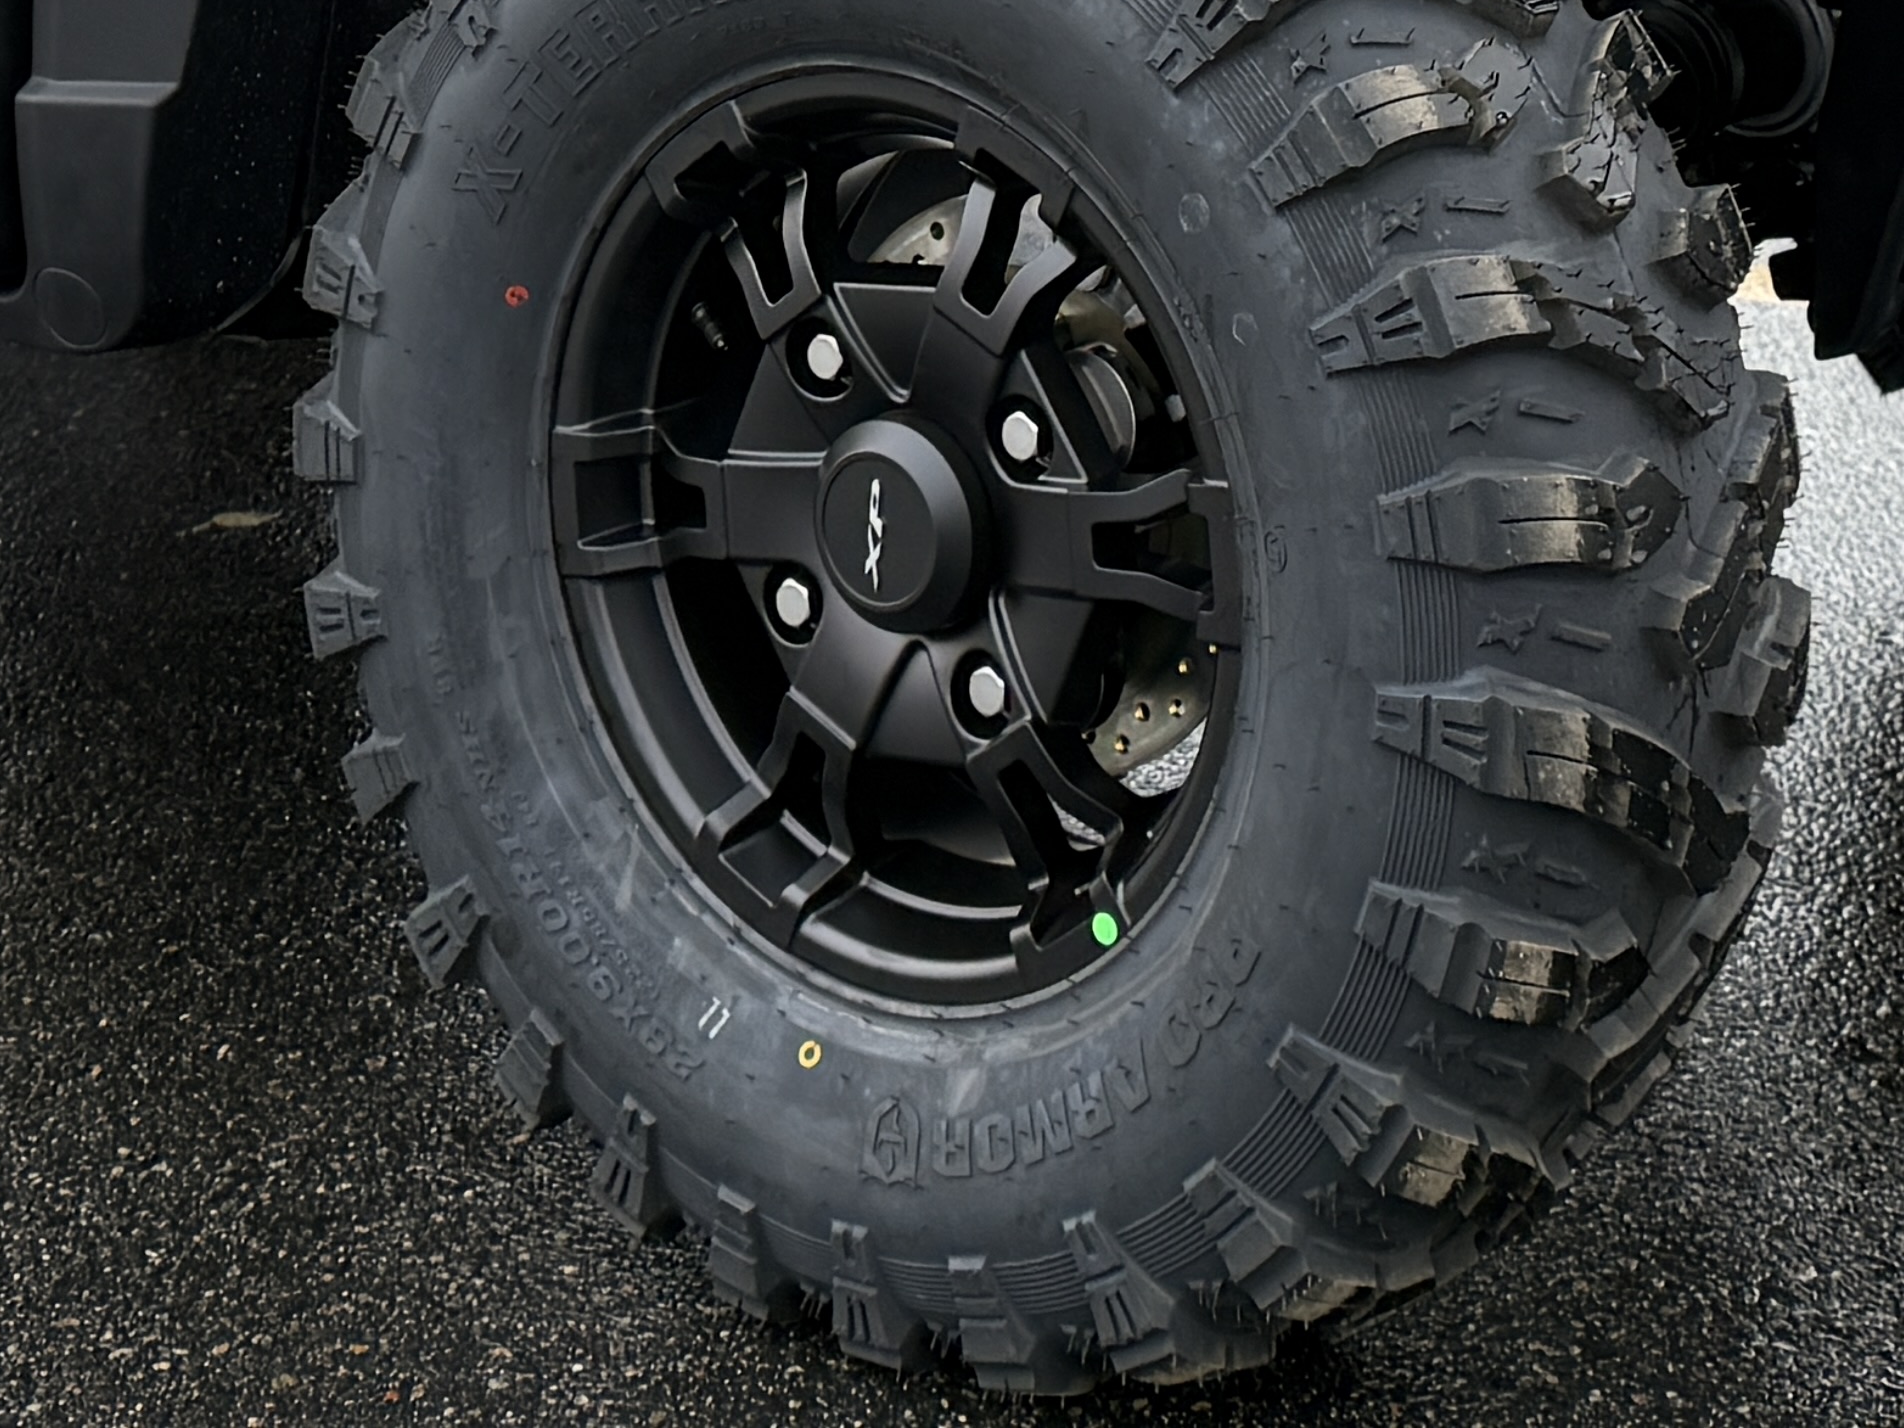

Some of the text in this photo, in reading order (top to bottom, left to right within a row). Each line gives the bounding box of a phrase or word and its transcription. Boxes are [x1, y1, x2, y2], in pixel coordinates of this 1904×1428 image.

[863, 478, 887, 593] XP
[931, 937, 1261, 1178] PRO ARMOR
